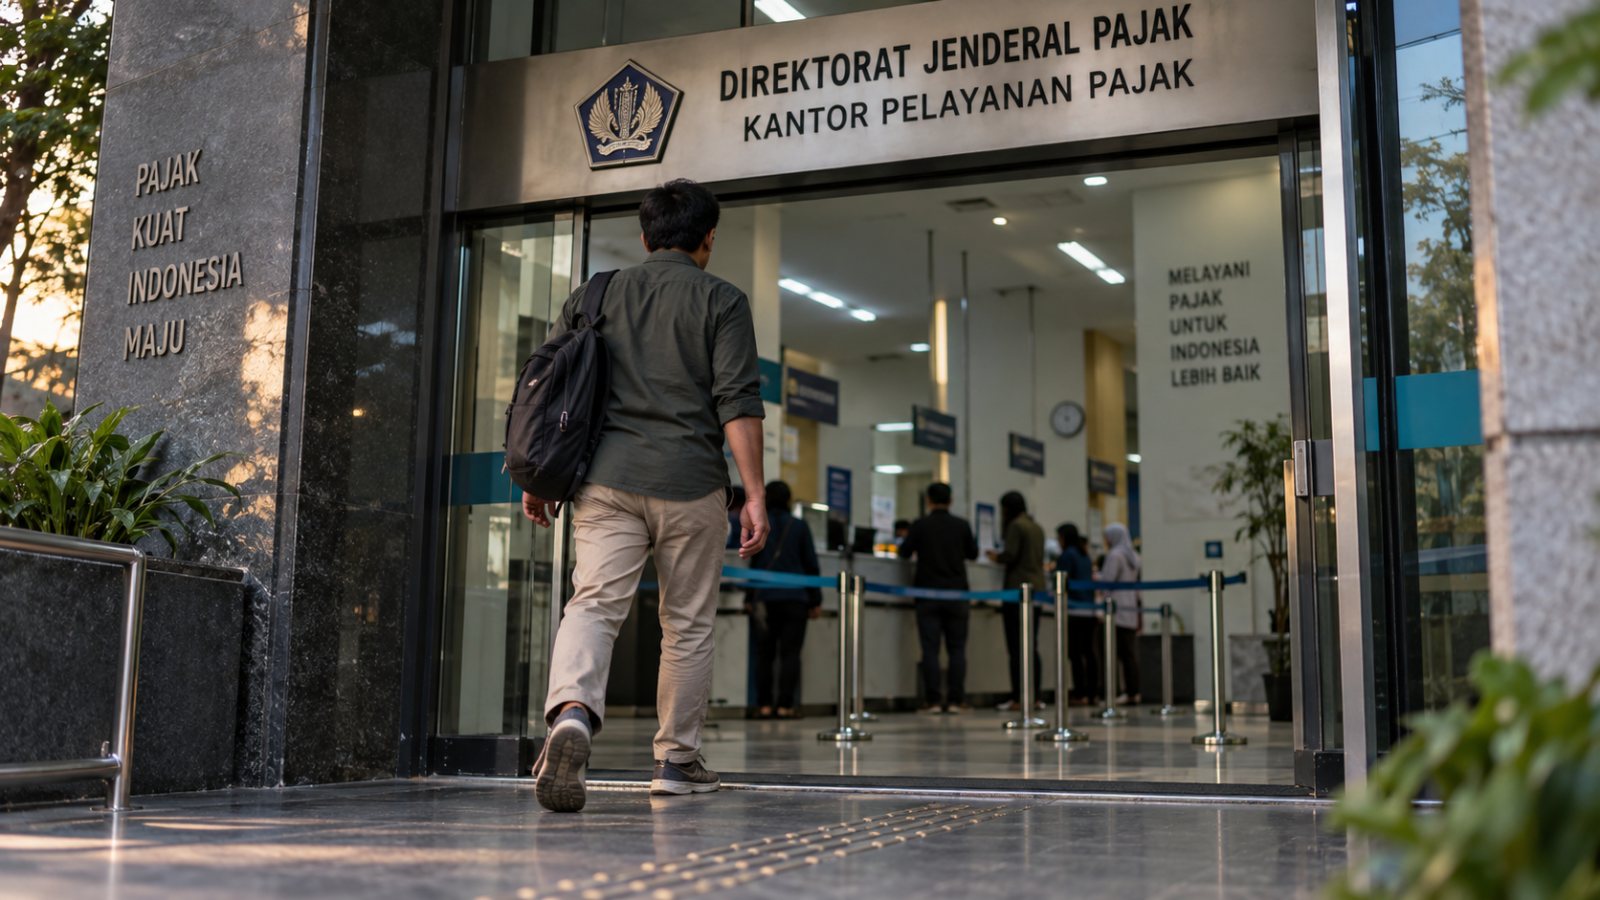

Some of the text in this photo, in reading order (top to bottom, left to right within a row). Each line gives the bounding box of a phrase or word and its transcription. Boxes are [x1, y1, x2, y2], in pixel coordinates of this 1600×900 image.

[719, 3, 1194, 102] DIREKTORAT JENDERAL PAJAK
[744, 57, 1195, 142] KANTOR PELAYANAN PAJAK
[136, 149, 202, 197] PAJAK
[131, 206, 190, 250] KUAT
[127, 251, 243, 306] INDONESIA
[1168, 261, 1251, 286] MELAYANI
[1169, 289, 1223, 310] PAJAK
[123, 318, 186, 361] MAJU
[1169, 314, 1228, 336] UNTUK
[1170, 337, 1260, 361] INDONESIA
[1171, 363, 1261, 388] LEBIH BAIK
